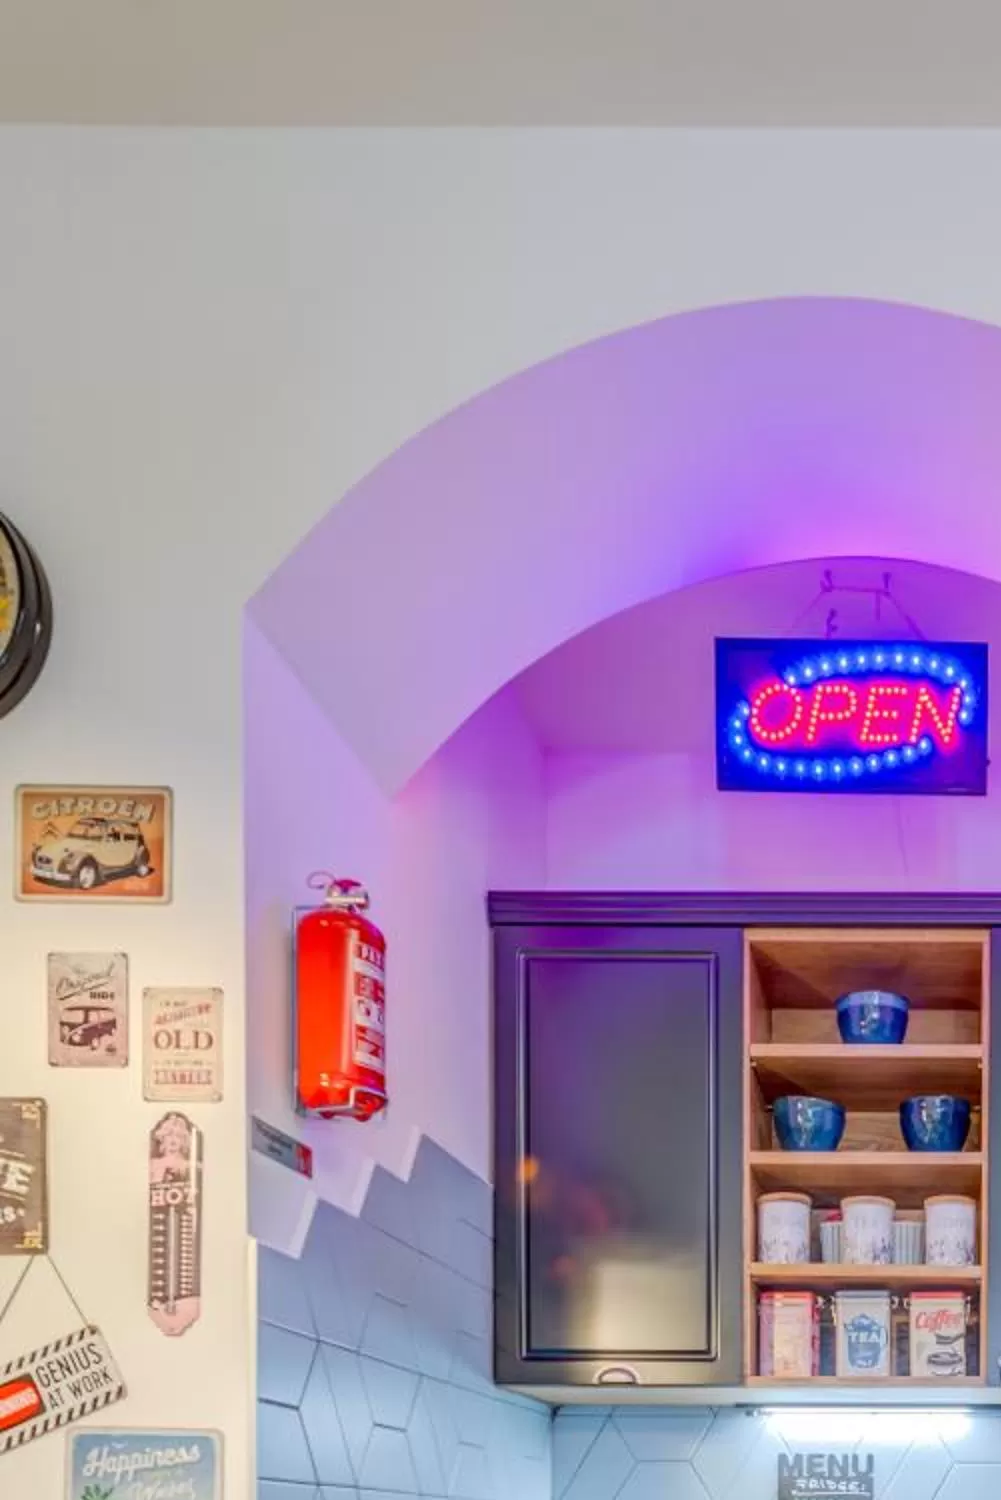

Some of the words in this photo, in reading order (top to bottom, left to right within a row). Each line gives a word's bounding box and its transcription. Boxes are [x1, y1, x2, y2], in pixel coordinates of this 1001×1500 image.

[751, 682, 962, 744] OPEN
[154, 1029, 213, 1051] OLD
[850, 1332, 881, 1343] TEA
[36, 1343, 102, 1388] GENIUS
[48, 1387, 64, 1409] AT
[67, 1366, 113, 1400] WORK
[82, 1444, 201, 1483] Happiness
[778, 1454, 874, 1475] MENU
